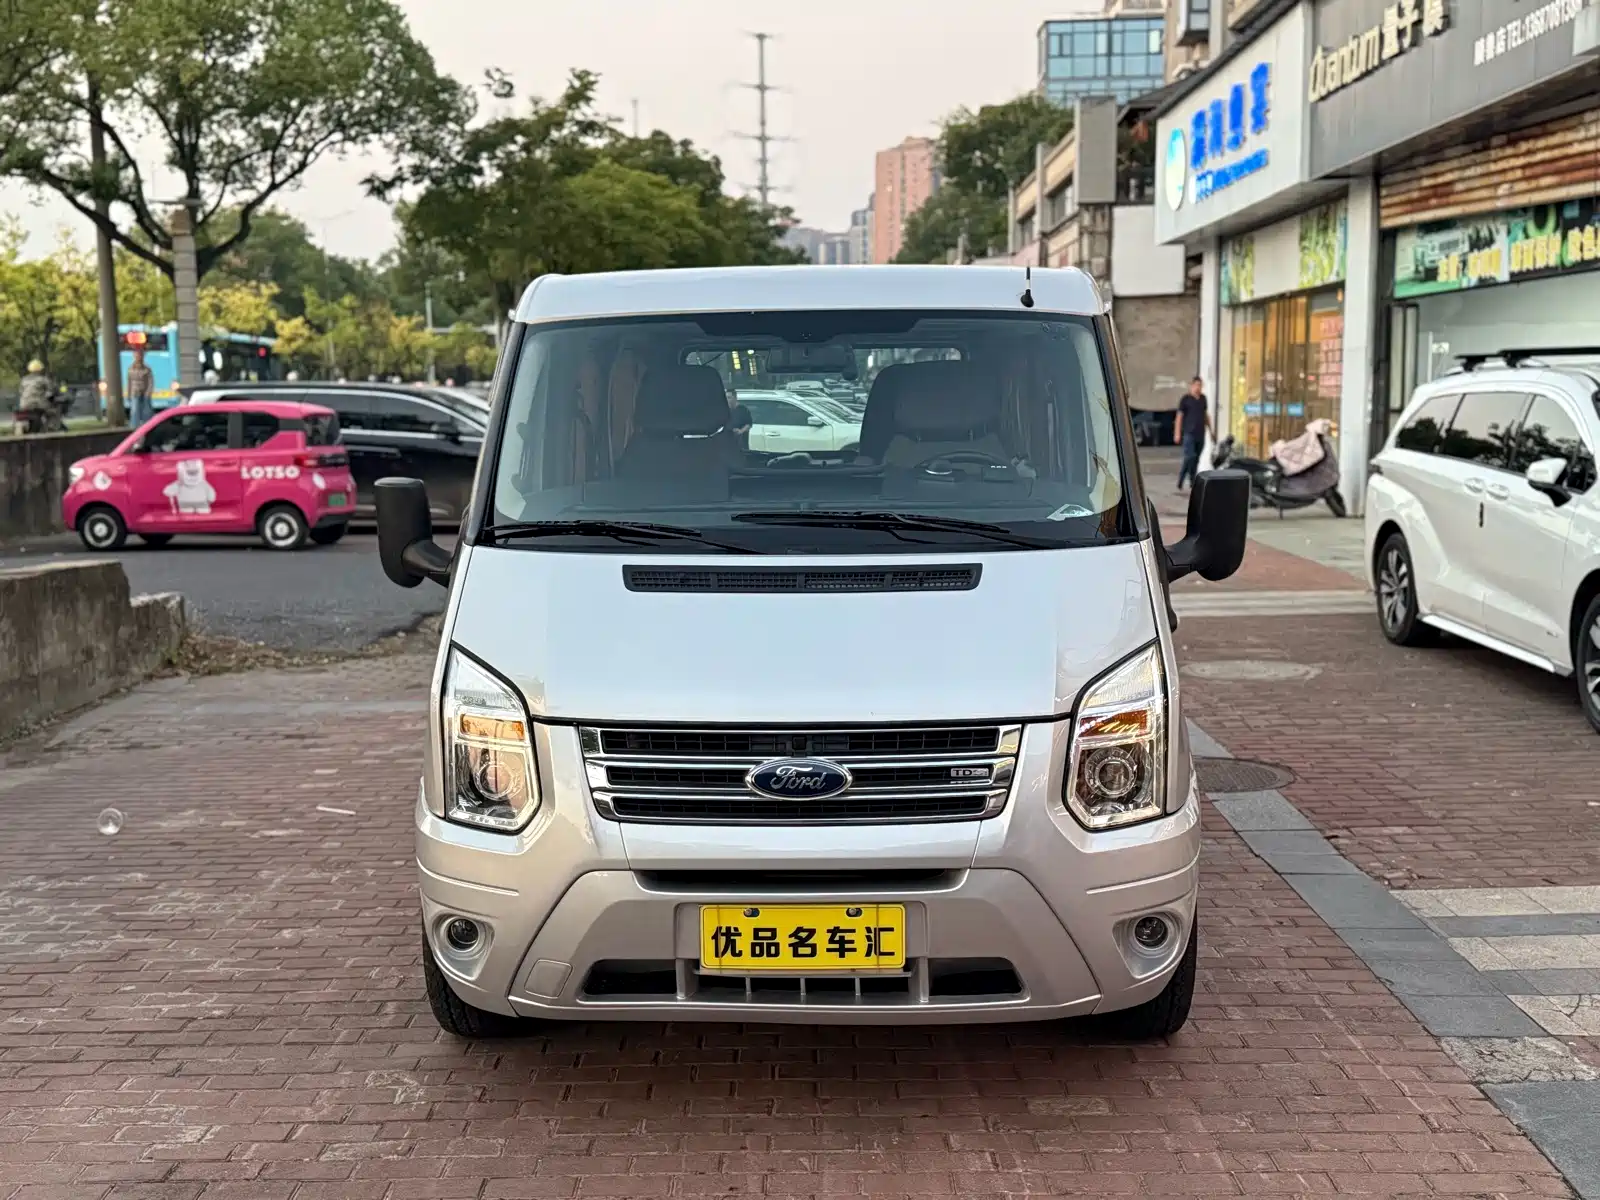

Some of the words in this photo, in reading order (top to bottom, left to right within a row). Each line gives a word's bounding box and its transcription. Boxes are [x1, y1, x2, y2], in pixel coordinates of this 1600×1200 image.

[241, 466, 300, 480] LOTSO
[770, 766, 827, 790] Ford
[711, 926, 896, 959] 优品名车汇
